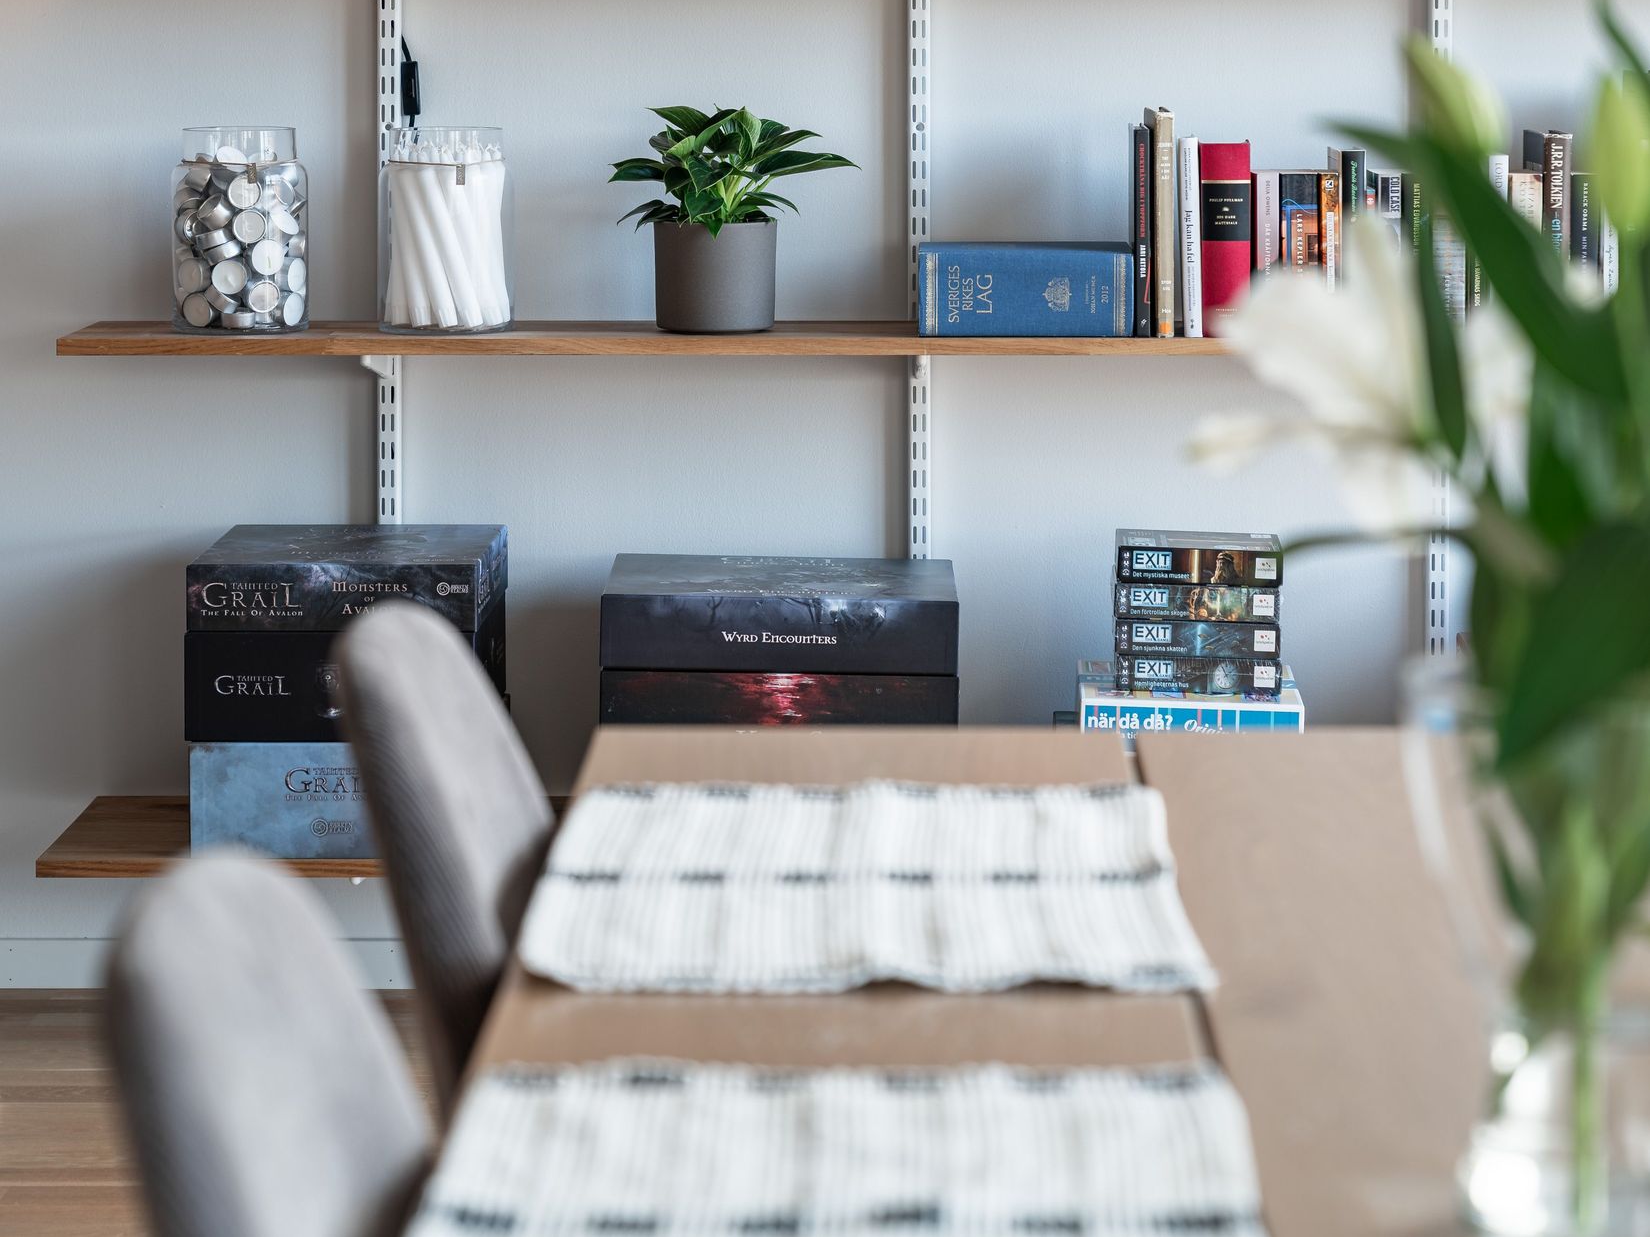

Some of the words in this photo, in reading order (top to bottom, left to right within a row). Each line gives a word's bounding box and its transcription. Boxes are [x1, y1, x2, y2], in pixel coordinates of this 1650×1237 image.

[1551, 143, 1564, 170] J.R.R.
[1390, 176, 1400, 194] COLD
[1551, 170, 1563, 209] TOLKIEN
[1390, 195, 1400, 213] CASE
[1413, 183, 1421, 208] MATTIAS
[1184, 209, 1194, 223] Jag
[1185, 224, 1194, 240] kan
[1139, 244, 1147, 257] JARI
[1186, 241, 1195, 251] ha
[1296, 236, 1304, 265] KEPLER
[1186, 252, 1195, 264] fel
[1139, 258, 1147, 278] KETOLA
[948, 265, 960, 323] SVERIGES
[962, 278, 974, 311] RIKES
[976, 273, 993, 314] LAG
[1101, 285, 1109, 304] 2012
[1135, 552, 1171, 568] EXIT
[1143, 571, 1169, 580] mystiska
[202, 582, 302, 608] GRAIL
[232, 582, 278, 590] TAINTED
[1133, 590, 1167, 605] EXIT
[1135, 625, 1170, 641] EXIT
[1136, 661, 1172, 677] EXIT
[214, 675, 292, 696] GRAIL
[1087, 713, 1116, 729] när
[1118, 713, 1140, 730] då
[1143, 713, 1174, 731] då?
